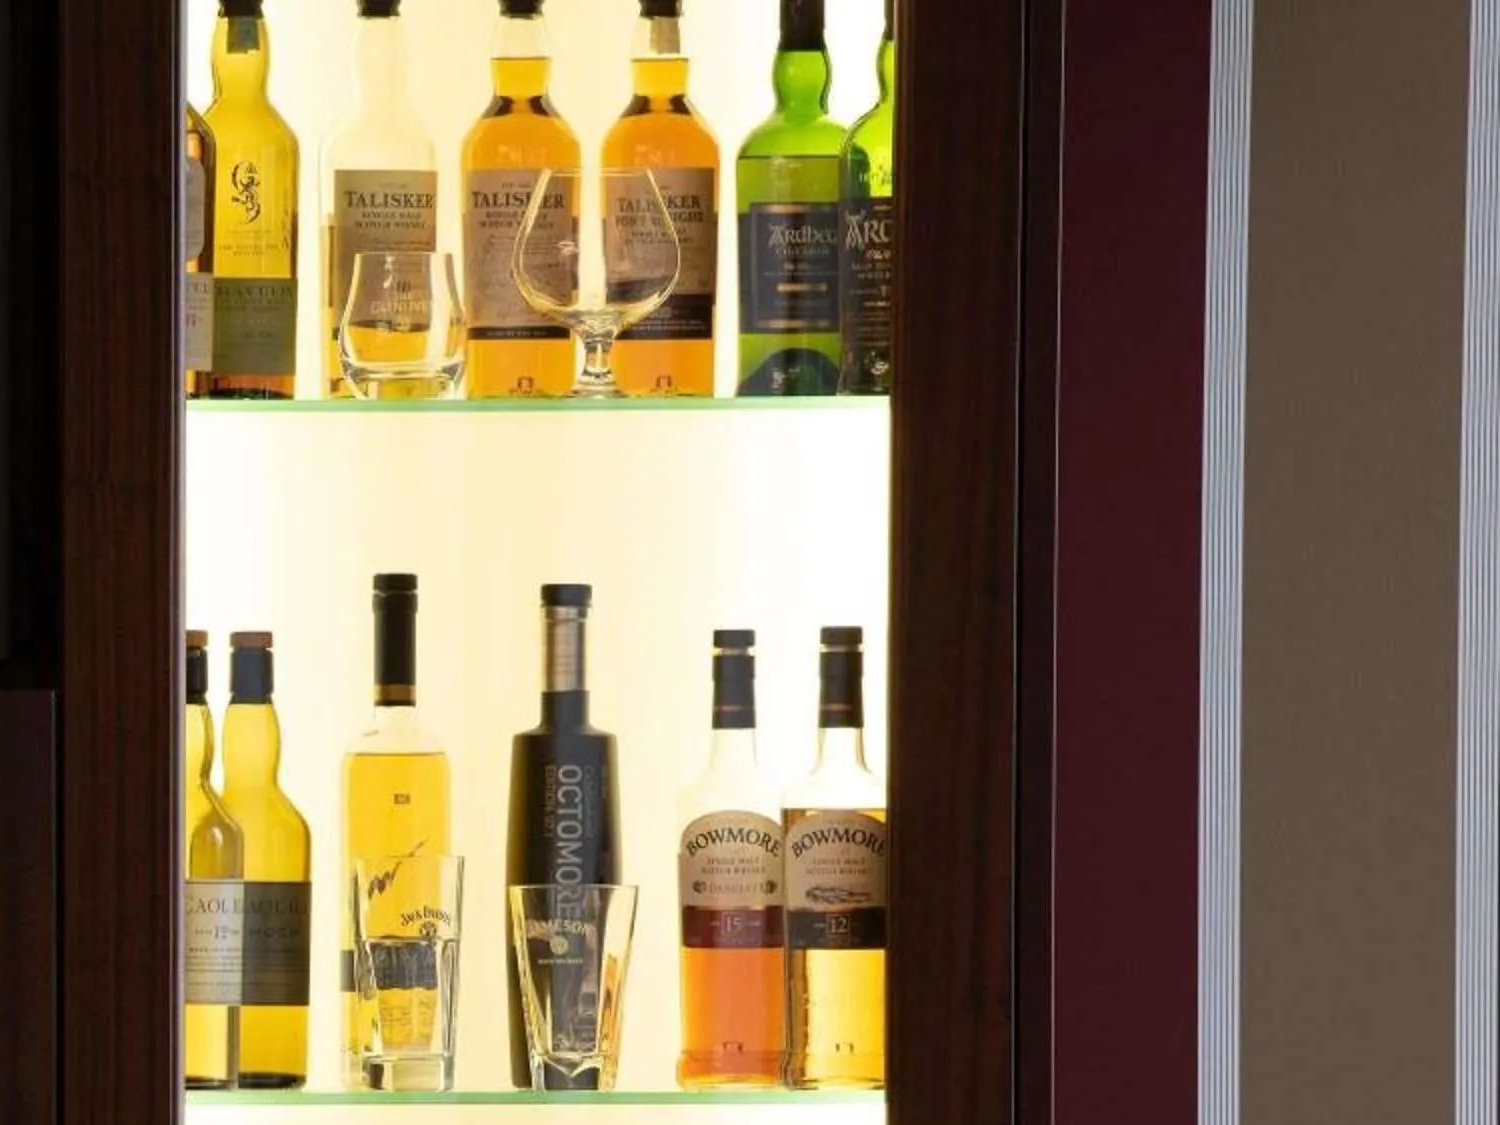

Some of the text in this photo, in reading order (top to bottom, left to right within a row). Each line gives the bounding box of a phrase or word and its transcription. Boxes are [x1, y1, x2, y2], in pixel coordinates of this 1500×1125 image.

[345, 190, 434, 208] TALISKER
[617, 193, 701, 212] TALIKER
[556, 765, 583, 919] OCTOMORE
[686, 827, 780, 858] BOWMORE
[791, 828, 886, 858] BOWMORE
[830, 917, 848, 934] 12
